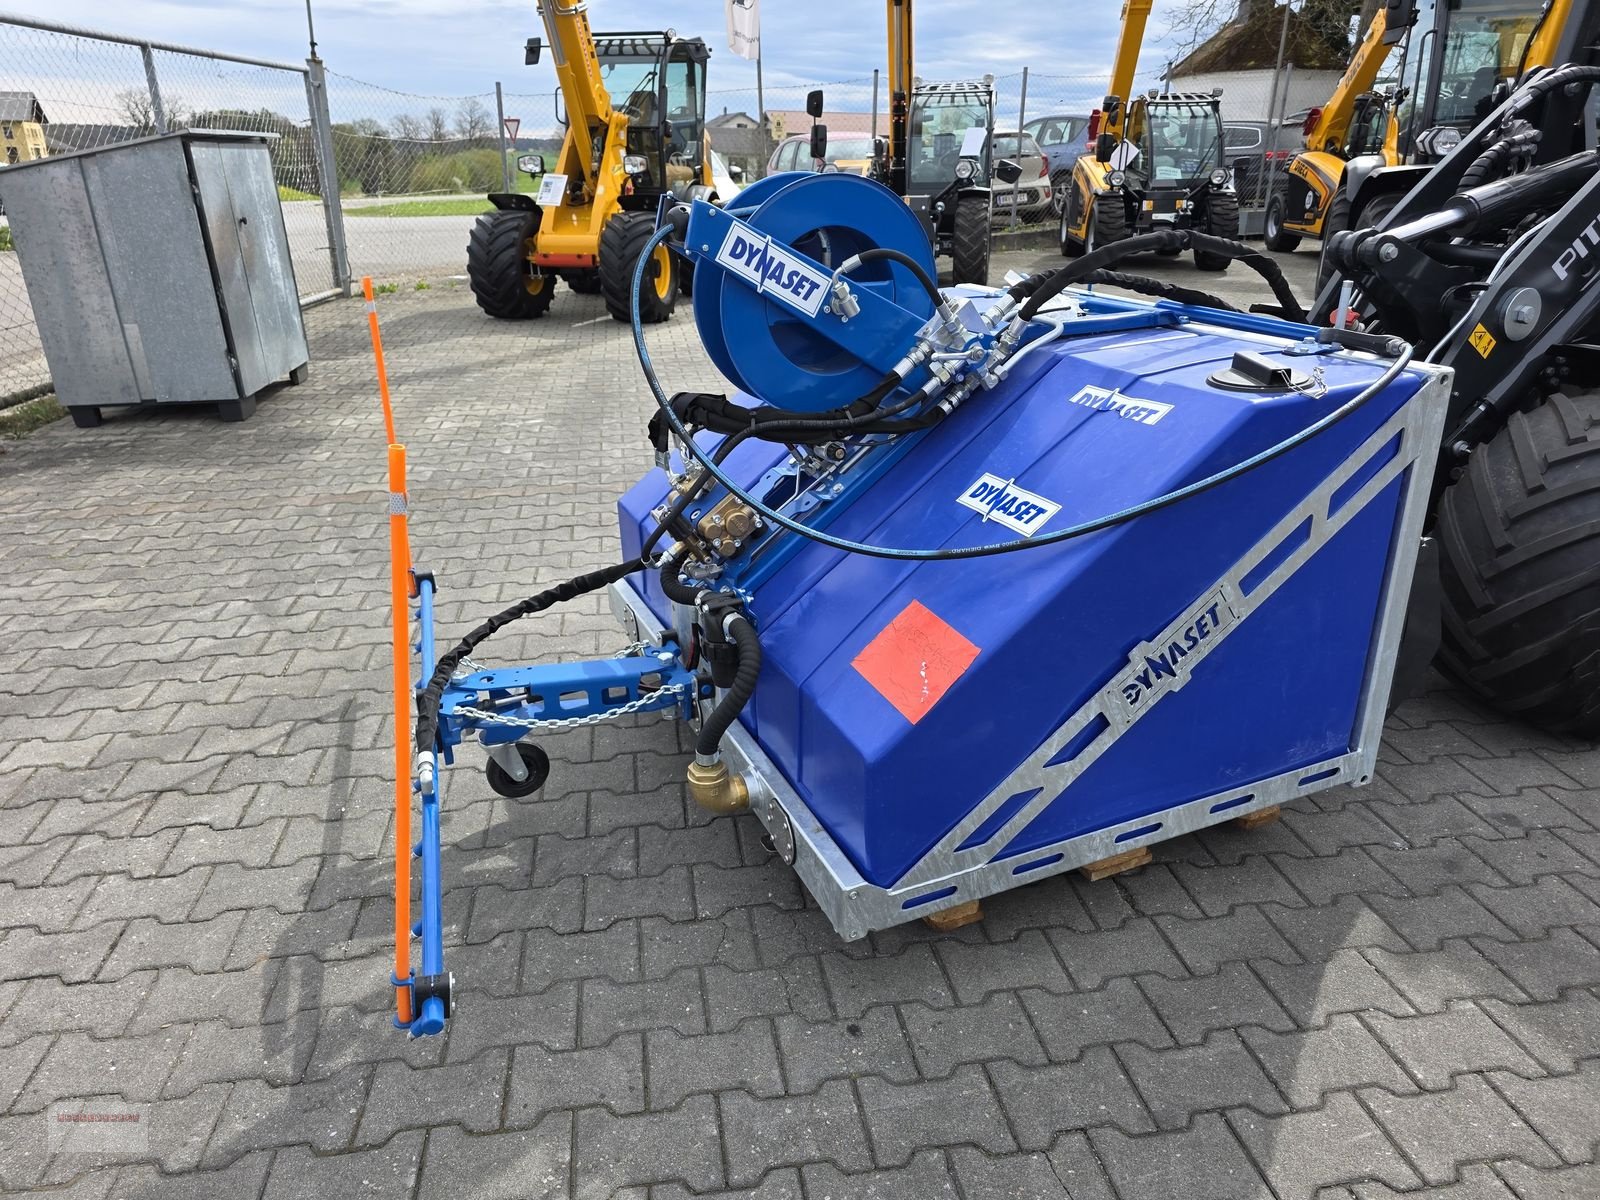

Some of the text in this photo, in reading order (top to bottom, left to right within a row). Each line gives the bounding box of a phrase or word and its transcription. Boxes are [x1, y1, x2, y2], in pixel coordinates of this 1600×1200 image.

[728, 235, 821, 302] DYNASET
[1552, 213, 1600, 281] PIT
[1078, 390, 1160, 423] DYNASET
[969, 481, 1049, 525] DYNASET
[1121, 601, 1220, 706] DYNASET
